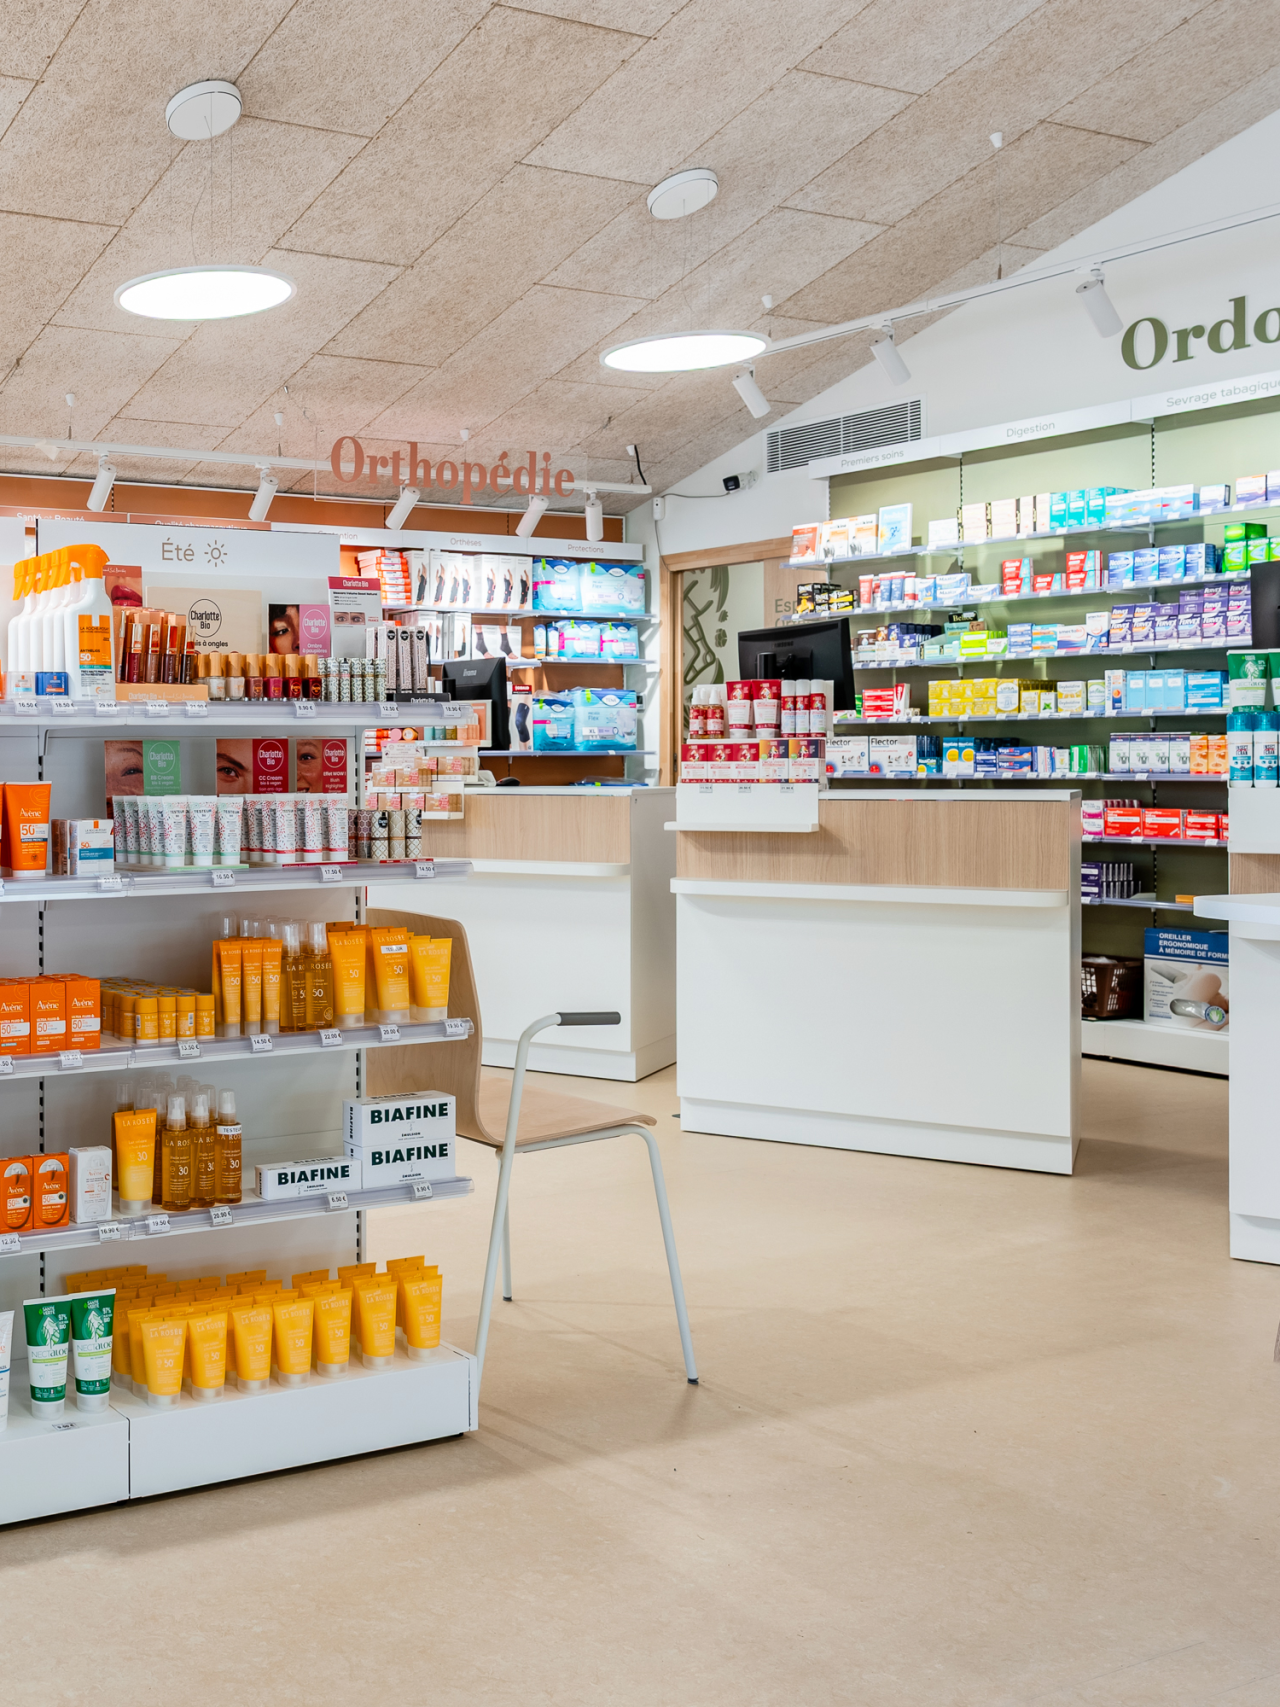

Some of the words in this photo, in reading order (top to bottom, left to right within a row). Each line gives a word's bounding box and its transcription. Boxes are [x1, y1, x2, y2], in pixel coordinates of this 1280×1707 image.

[1120, 296, 1280, 370] Ordo
[1166, 388, 1217, 408] Sevrage
[1006, 420, 1055, 440] Digestion
[840, 454, 879, 468] Premiers
[882, 450, 904, 463] soins
[330, 436, 575, 505] Orthopédie
[450, 537, 482, 548] Orthèses
[162, 538, 195, 562] Été
[567, 544, 604, 554] Protections
[190, 610, 220, 621] Charlotte
[200, 621, 211, 630] Bio
[304, 618, 326, 627] Charlotte
[311, 626, 319, 634] Bio
[208, 640, 229, 648] ongles
[871, 737, 898, 746] Flector
[149, 752, 174, 761] Charlotte
[258, 750, 283, 758] Charlotte
[324, 749, 345, 757] Charlotte
[157, 760, 167, 768] Bio
[267, 757, 275, 765] Bio
[20, 808, 42, 817] Avène
[344, 937, 364, 945] ROSÉE
[387, 934, 405, 942] ROSÉE
[1159, 932, 1192, 942] OREILLER
[1159, 940, 1209, 951] ERGONOMIQUE
[1165, 947, 1196, 956] MÉMOIRE
[1207, 952, 1228, 960] FORM
[0, 1002, 23, 1012] Avène
[37, 1000, 60, 1011] Avène
[370, 1102, 449, 1125] BIAFINE
[122, 1119, 131, 1127] LA
[132, 1117, 154, 1126] ROSÉE
[137, 1151, 148, 1162] 30
[371, 1143, 449, 1166] BIAFINE
[230, 1159, 240, 1169] 30
[178, 1166, 189, 1176] 30
[277, 1165, 350, 1186] BIAFINE
[160, 1328, 183, 1336] ROSÉE
